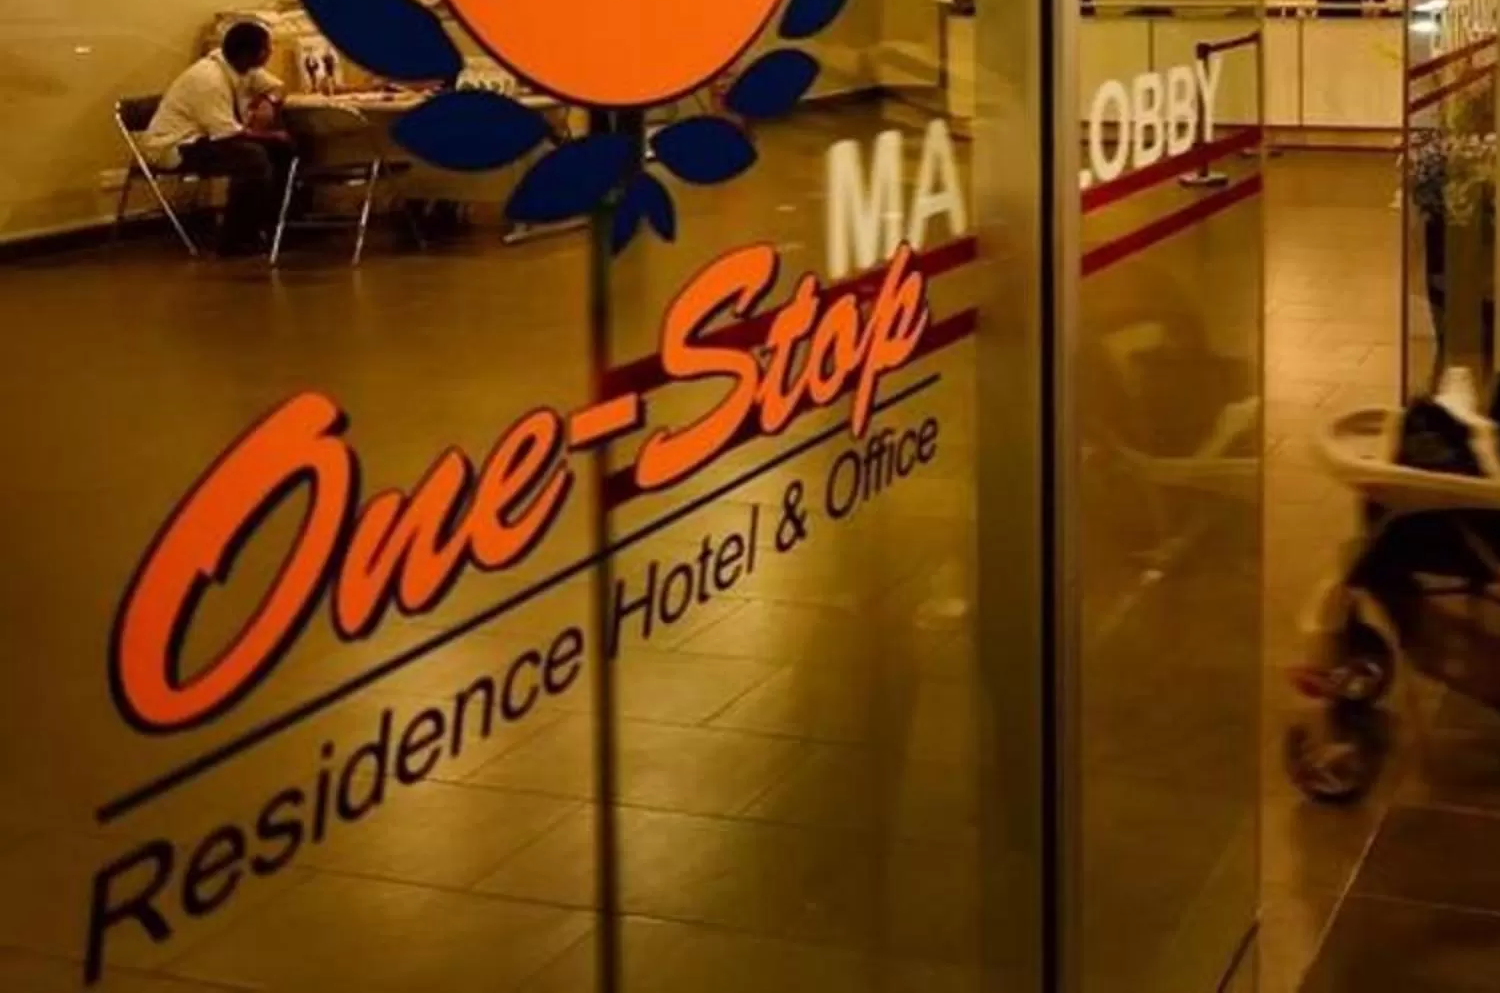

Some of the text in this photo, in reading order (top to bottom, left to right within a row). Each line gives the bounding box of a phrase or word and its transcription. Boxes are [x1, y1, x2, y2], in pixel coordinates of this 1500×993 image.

[826, 51, 1222, 281] MA OBBY
[82, 418, 938, 986] Residence Hotel & Office
[108, 239, 932, 736] One-Stop
